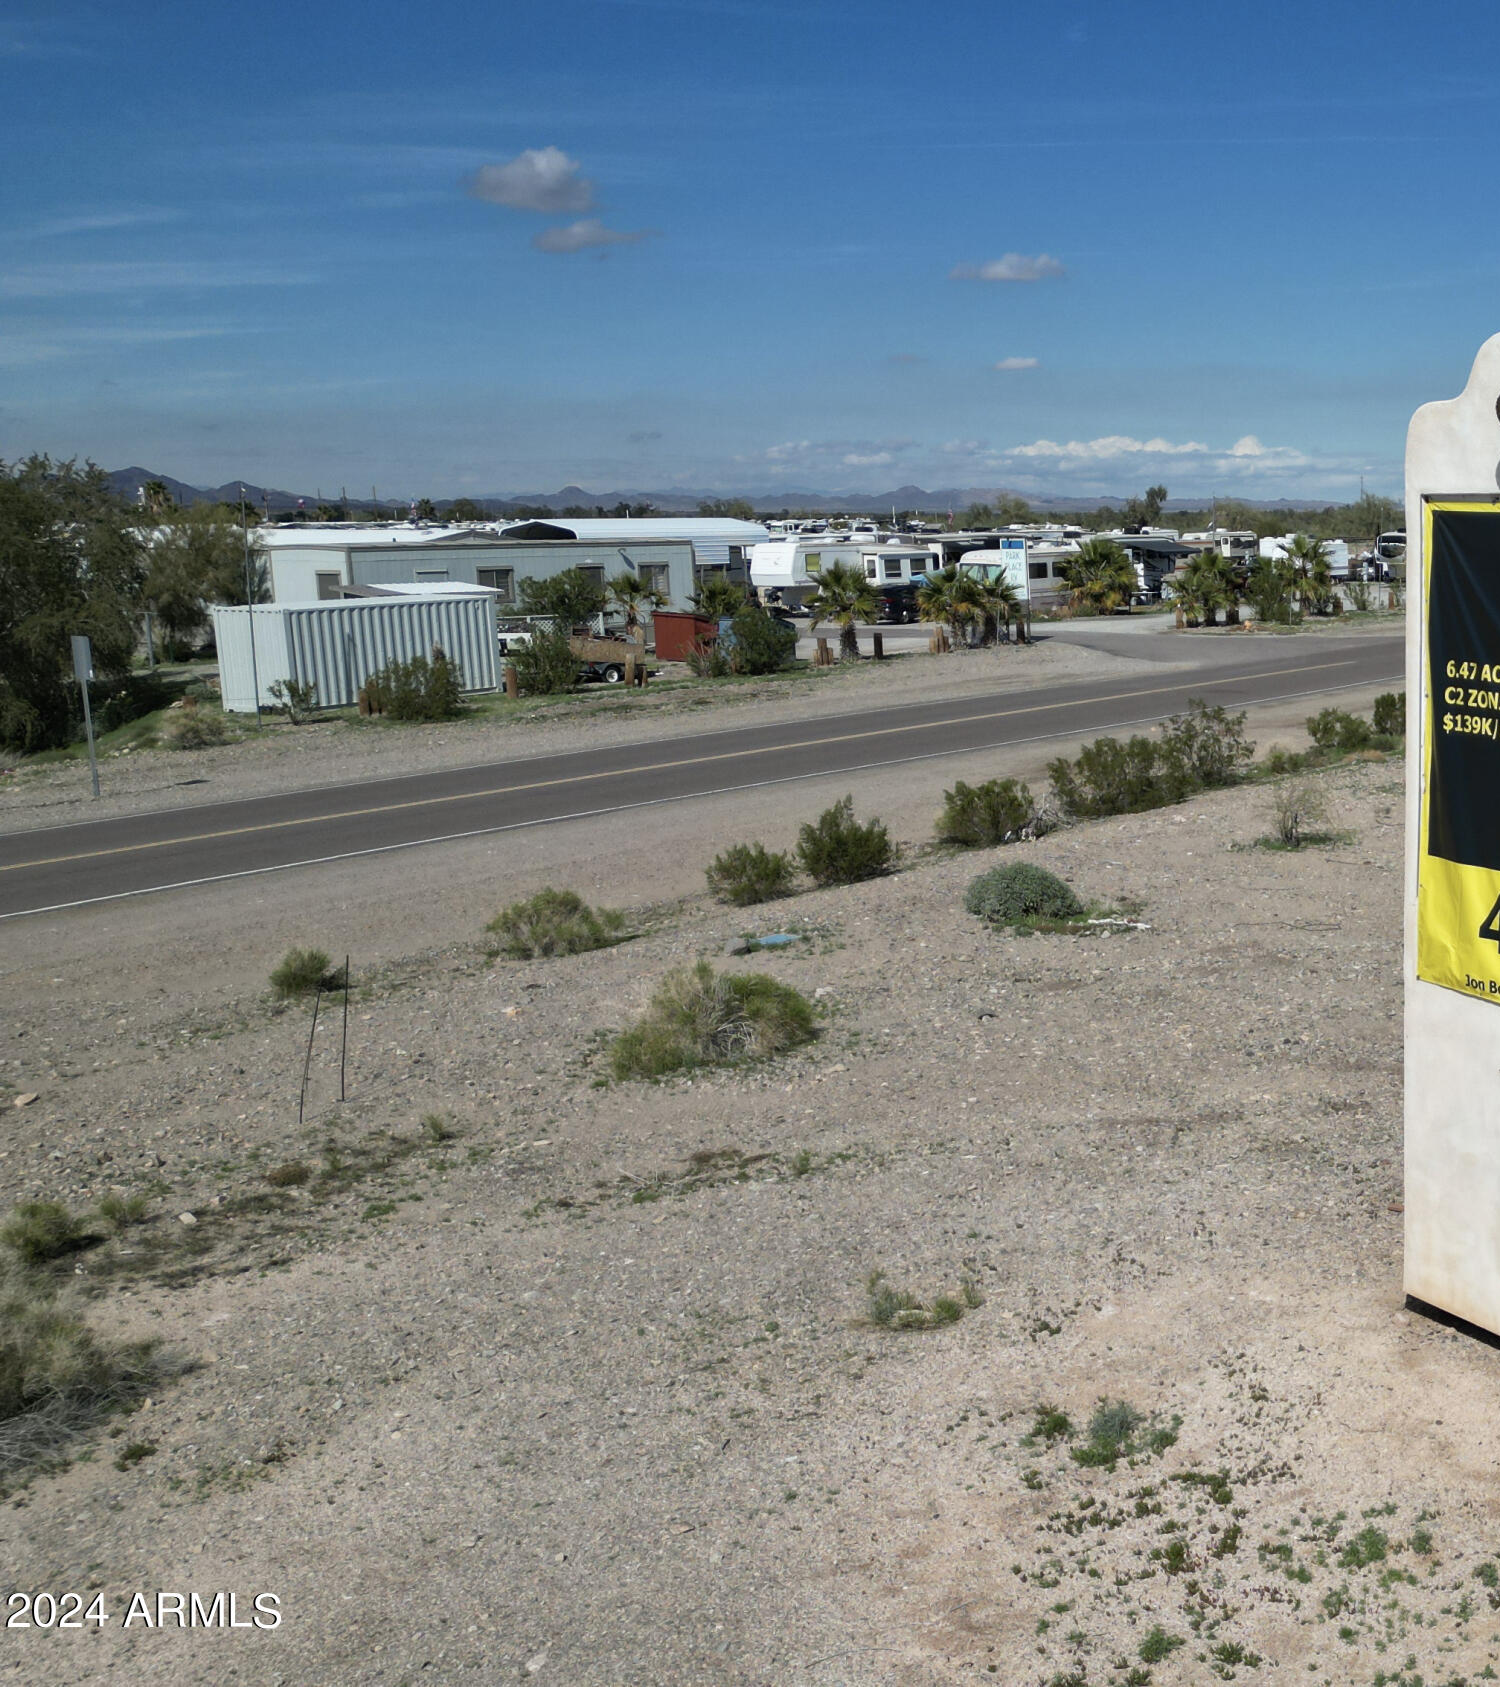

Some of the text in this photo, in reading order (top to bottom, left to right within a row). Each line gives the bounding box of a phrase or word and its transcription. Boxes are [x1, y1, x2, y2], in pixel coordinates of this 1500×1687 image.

[1446, 659, 1477, 680] 6.47
[1444, 686, 1464, 706] C2
[1464, 974, 1486, 992] Jon
